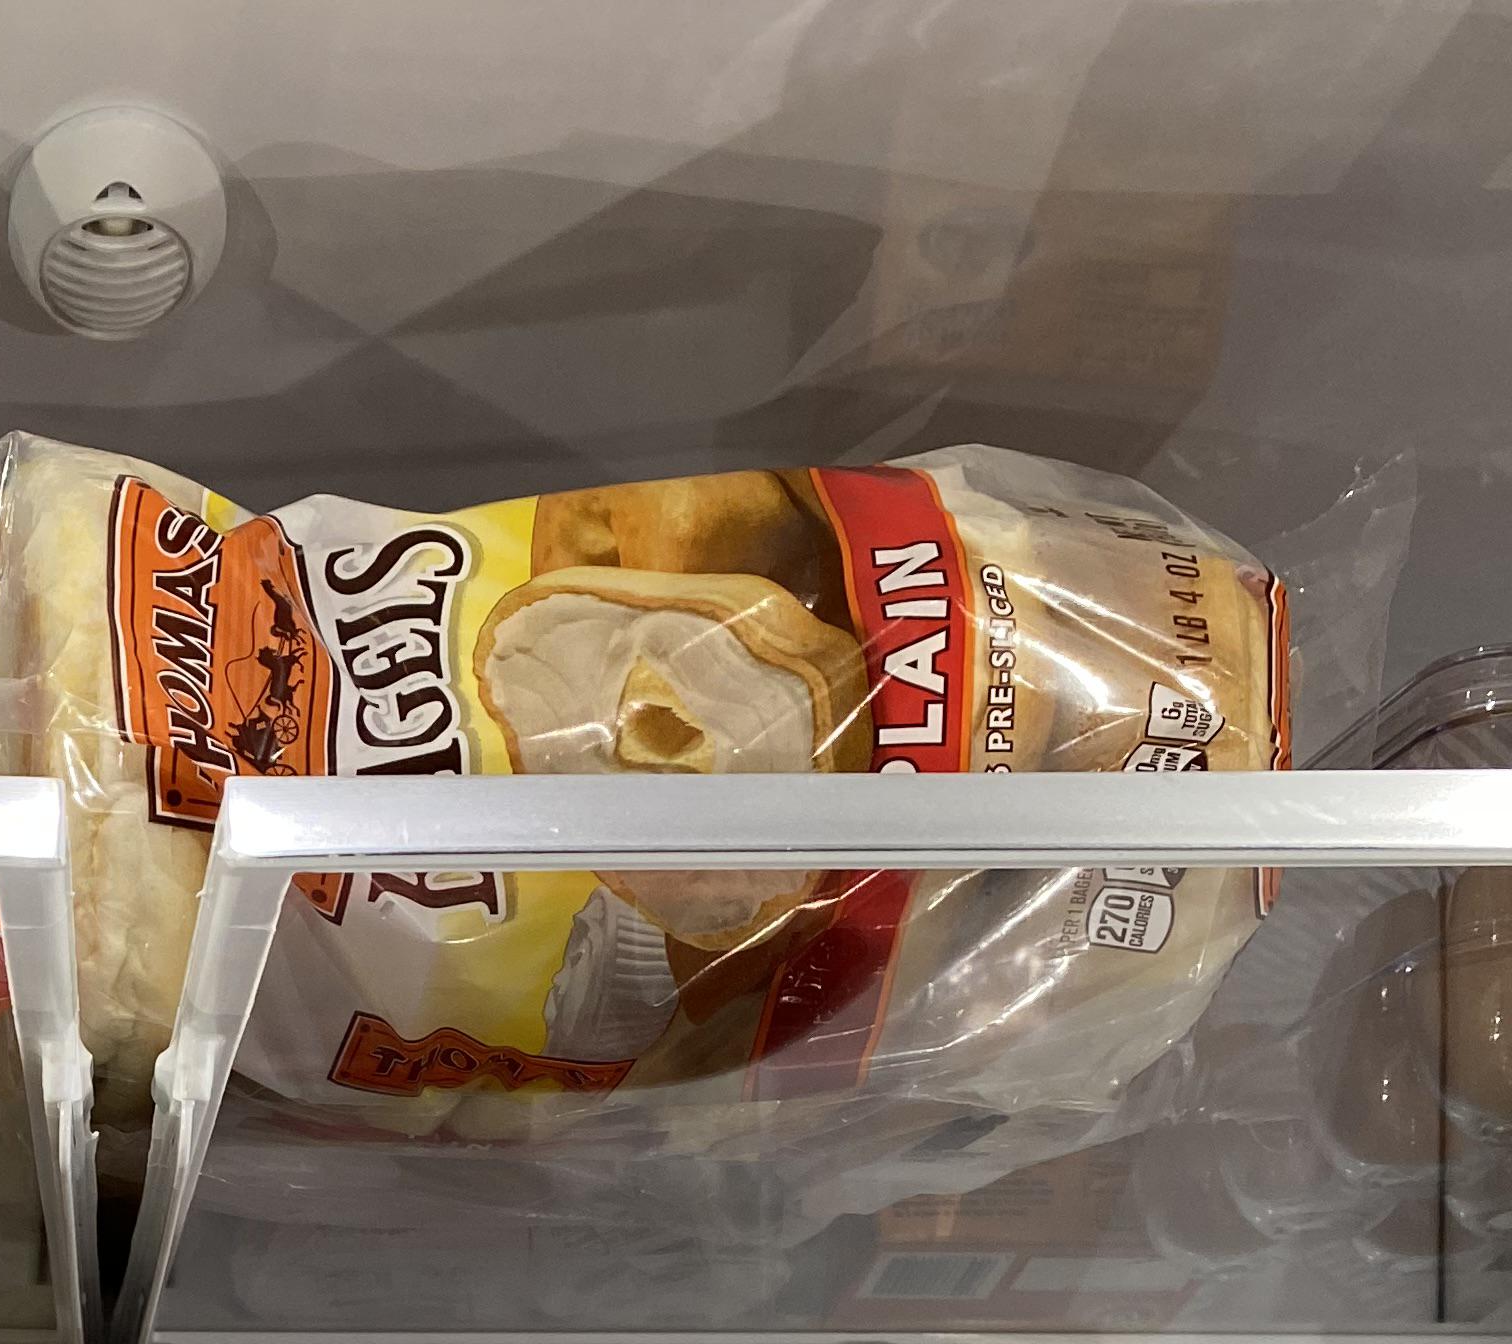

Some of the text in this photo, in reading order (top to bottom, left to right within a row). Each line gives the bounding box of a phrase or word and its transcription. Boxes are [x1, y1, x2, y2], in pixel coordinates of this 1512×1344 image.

[1162, 551, 1200, 579] OZ
[1169, 590, 1204, 604] 4
[1173, 614, 1210, 645] LB
[980, 563, 1017, 753] PRE-SLICED
[1161, 701, 1184, 720] 6g
[1060, 918, 1079, 943] PER
[1096, 894, 1135, 944] 270
[1129, 894, 1155, 947] CALORIES
